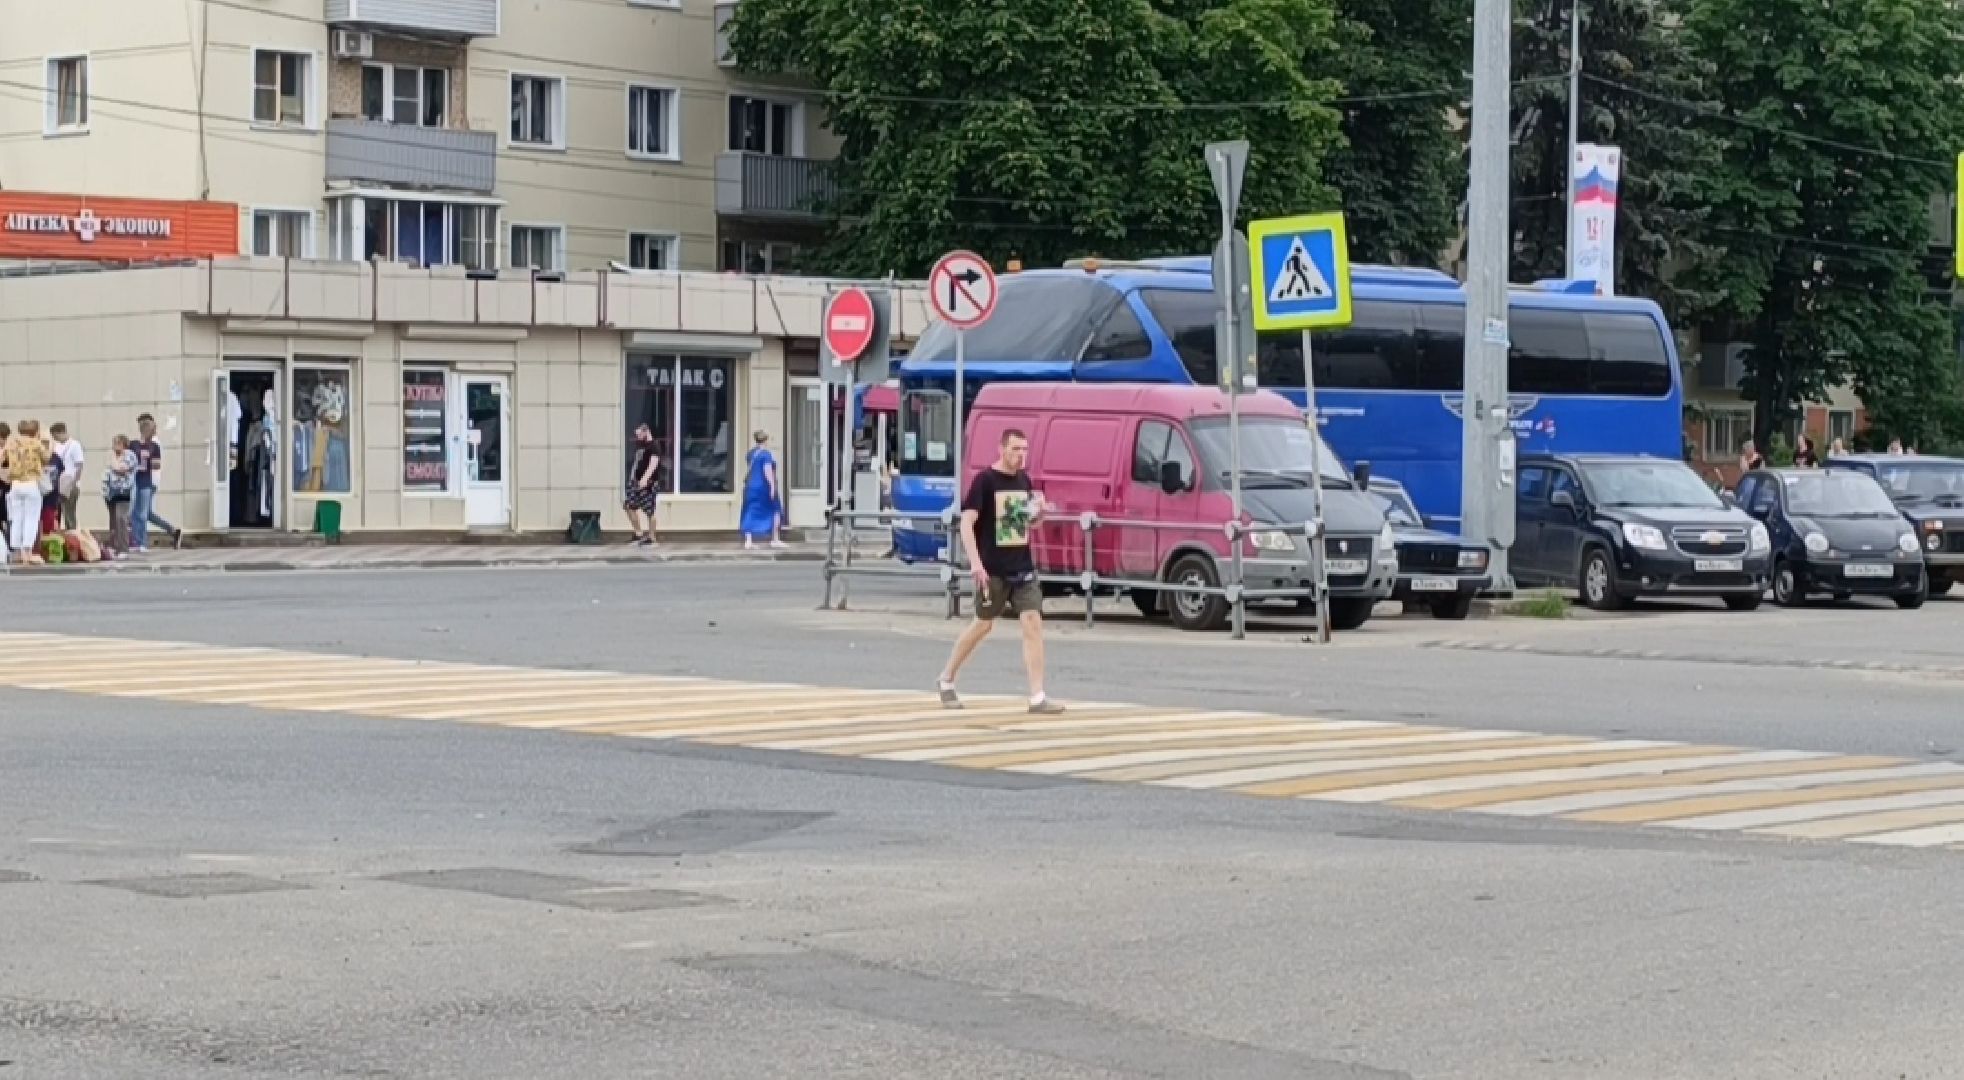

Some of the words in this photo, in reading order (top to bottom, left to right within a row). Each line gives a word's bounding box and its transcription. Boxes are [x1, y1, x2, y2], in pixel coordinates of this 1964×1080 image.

[5, 213, 69, 231] АПТЕКА
[105, 217, 170, 236] ЭКОНОМ
[403, 385, 446, 400] КУПКА
